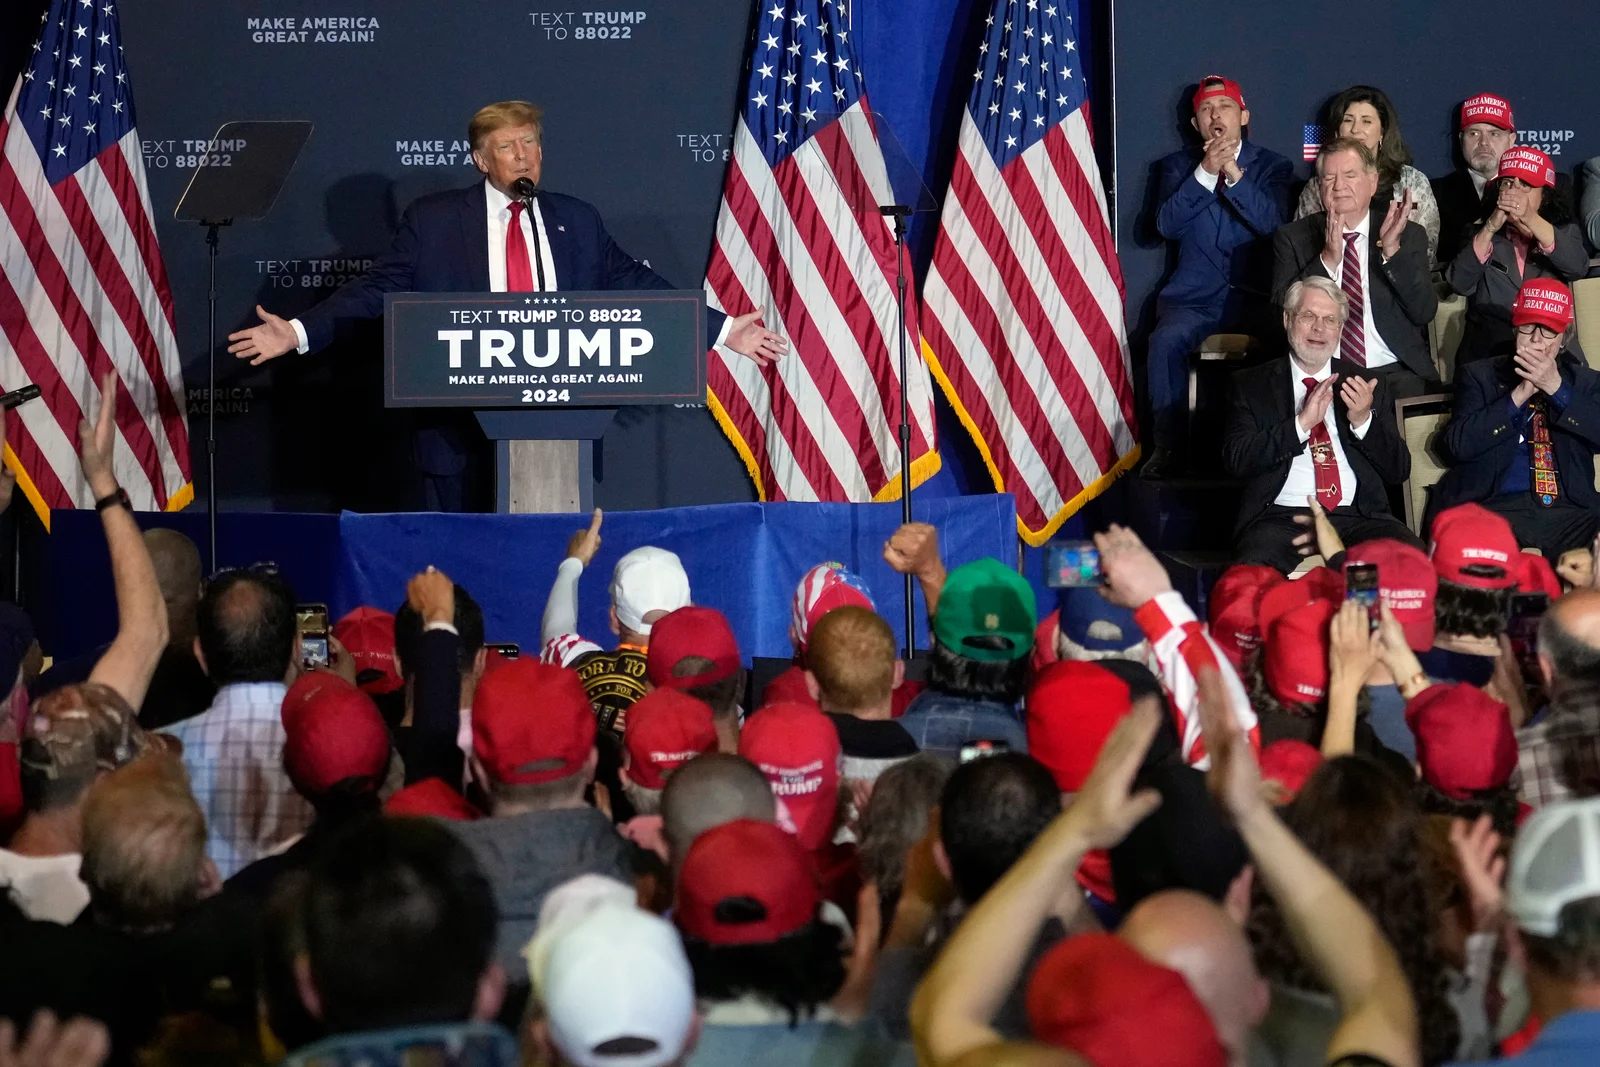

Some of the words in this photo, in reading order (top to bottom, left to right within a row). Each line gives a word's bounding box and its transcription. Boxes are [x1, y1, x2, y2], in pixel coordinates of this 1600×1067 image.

[247, 18, 296, 30] MAKE
[301, 17, 380, 29] AMERICA
[529, 12, 575, 25] TEXT
[582, 11, 646, 25] TRUMP
[252, 31, 309, 43] GREAT
[314, 30, 375, 43] AGAIN!
[543, 27, 568, 40] TO
[574, 26, 632, 40] 88022
[1463, 97, 1480, 109] MAKE
[1479, 96, 1507, 110] AMERICA
[1466, 106, 1484, 117] GREAT
[1484, 106, 1504, 118] AGAIN
[676, 134, 723, 148] TEXT
[1516, 130, 1575, 142] TRUMP
[141, 140, 176, 154] EXT
[183, 139, 247, 153] TRUMP
[396, 140, 444, 152] MAKE
[144, 155, 169, 169] TO
[175, 154, 232, 168] 88022
[401, 154, 457, 166] GREAT
[691, 149, 715, 162] TO
[1501, 151, 1517, 161] MAKE
[1516, 150, 1544, 166] AMERICA
[1501, 160, 1518, 171] GREAT
[1518, 160, 1539, 174] AGAIN
[255, 260, 302, 274] TEXT
[308, 259, 373, 273] TRUMP
[270, 275, 294, 288] TO
[1523, 288, 1540, 298] MAKE
[1540, 289, 1569, 305] AMERICA
[1523, 299, 1544, 310] GREAT
[1544, 302, 1564, 315] AGAIN
[450, 310, 493, 324] TEXT
[497, 309, 558, 323] TRUMP
[561, 309, 585, 323] TO
[589, 308, 642, 322] 88022
[437, 328, 654, 368] TRUMP
[449, 375, 485, 385] MAKE
[489, 374, 548, 384] AMERICA
[551, 374, 594, 384] GREAT
[598, 373, 643, 383] AGAIN!
[188, 387, 254, 400] MERICA
[521, 389, 571, 403] 2024
[581, 661, 618, 680] ORN
[624, 658, 647, 678] TO
[614, 684, 633, 696] FOR
[770, 776, 823, 796] RUMP
